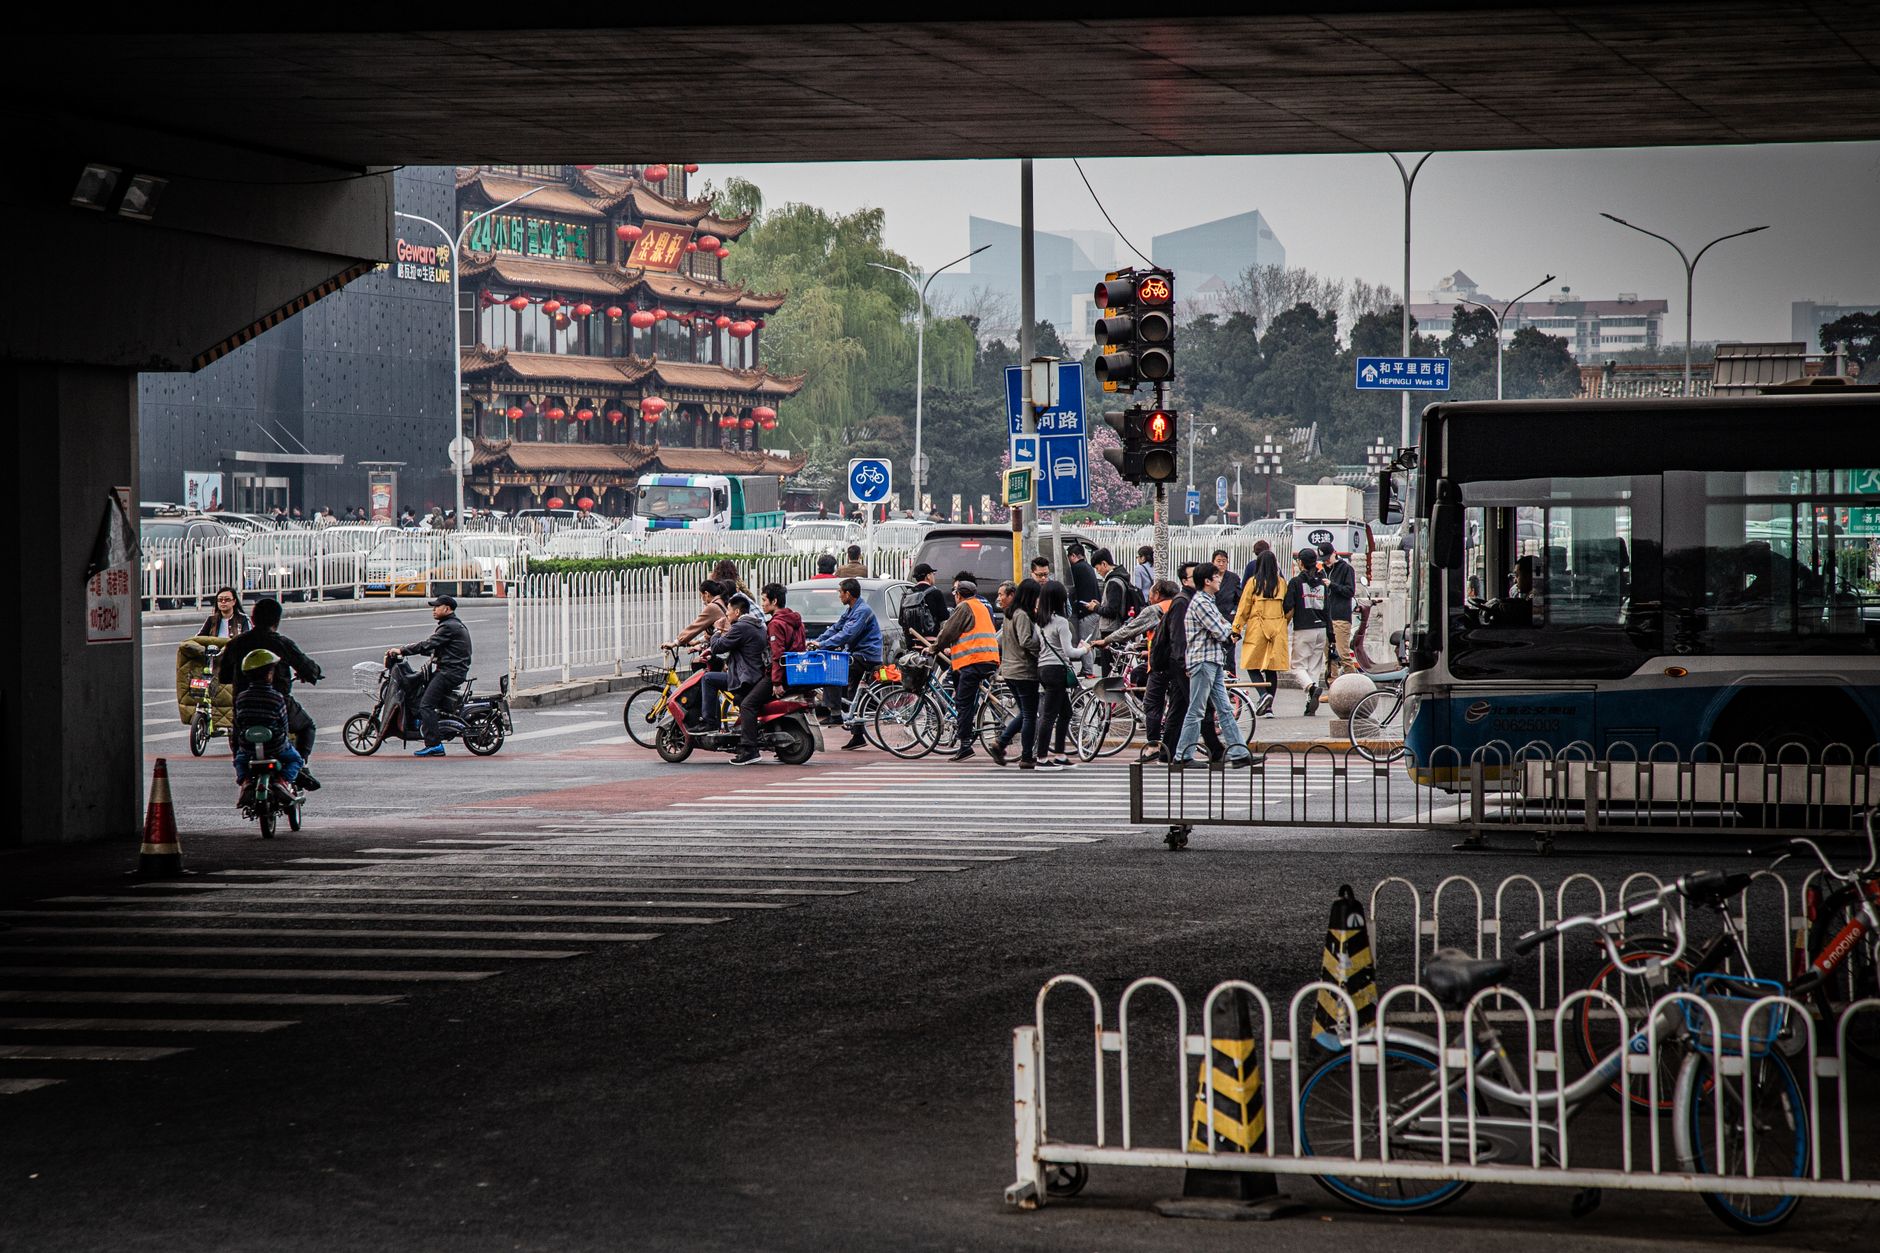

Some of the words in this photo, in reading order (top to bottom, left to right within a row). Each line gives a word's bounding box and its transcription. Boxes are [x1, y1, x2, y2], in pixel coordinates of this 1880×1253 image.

[397, 239, 436, 264] Gewara
[435, 268, 450, 283] LIVE
[1379, 362, 1445, 375] 和平里西街
[1311, 532, 1331, 544] 快递
[1829, 927, 1861, 964] mobike
